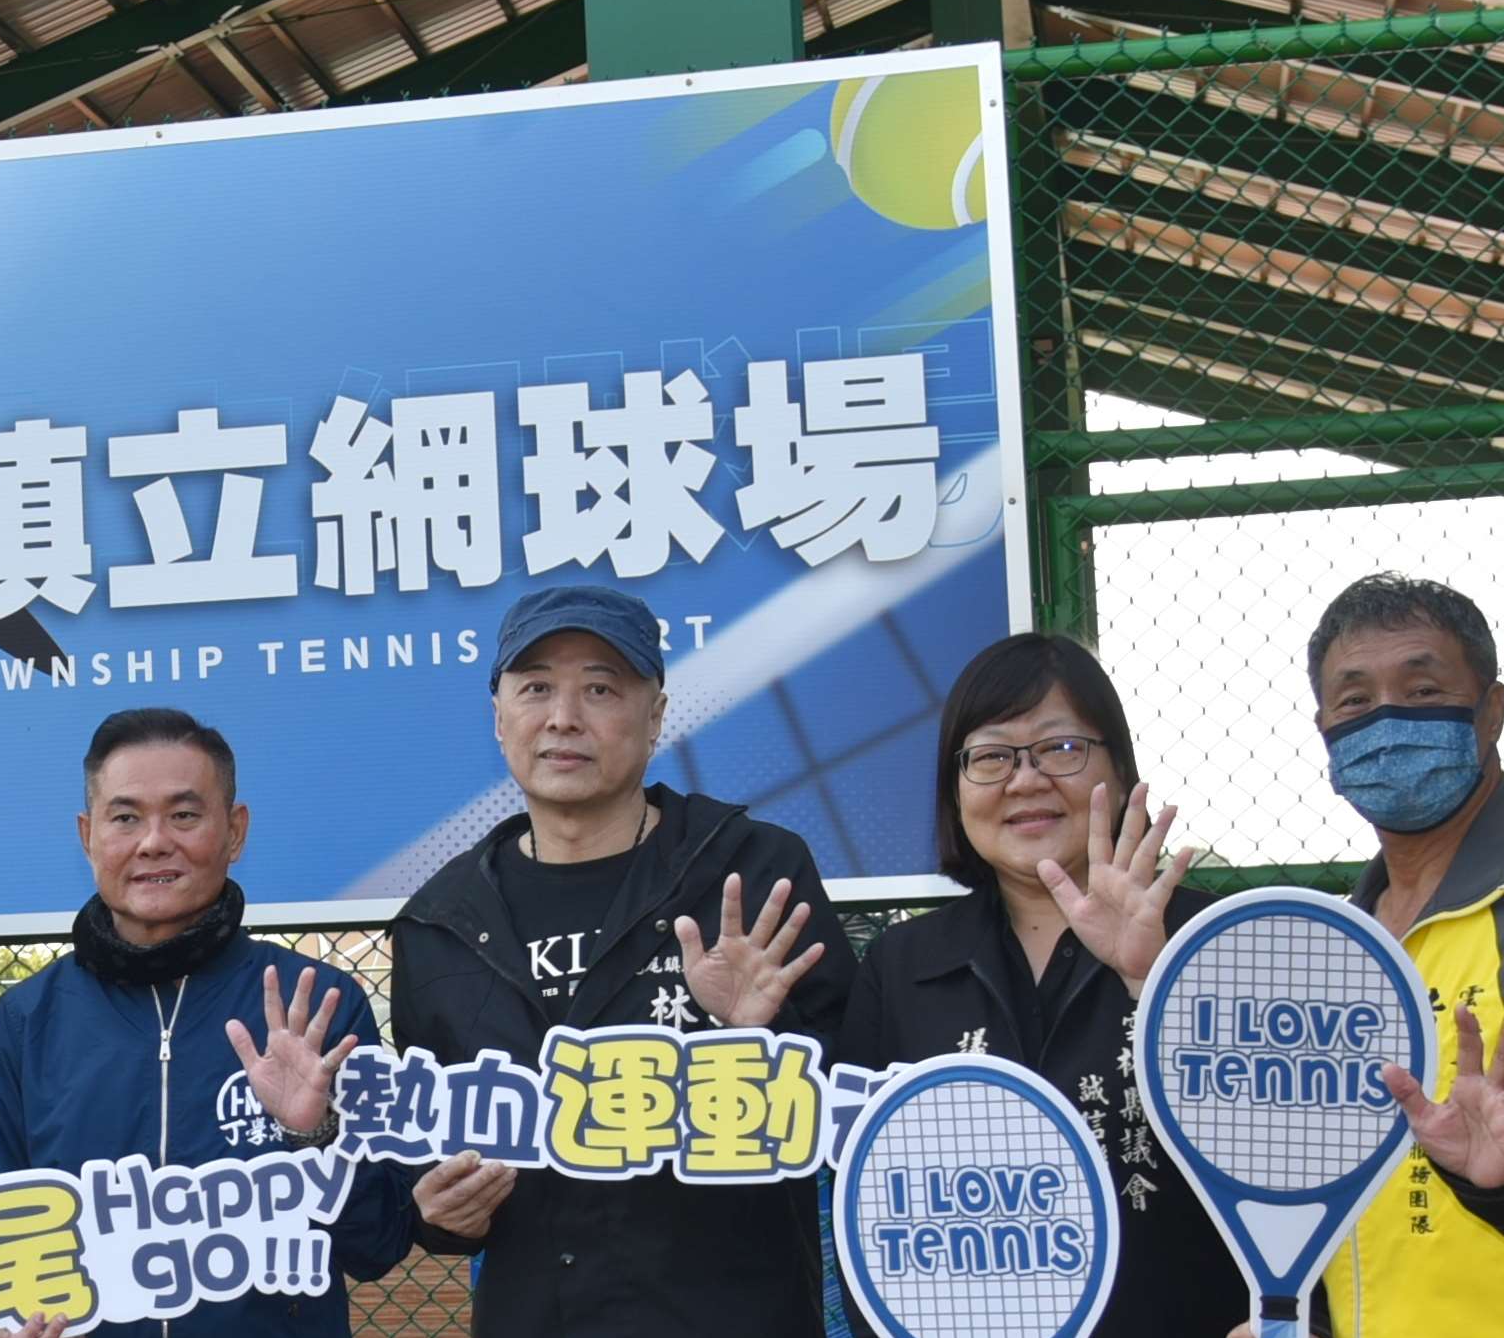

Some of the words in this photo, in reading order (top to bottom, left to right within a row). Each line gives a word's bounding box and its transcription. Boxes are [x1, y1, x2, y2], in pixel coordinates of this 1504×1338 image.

[258, 629, 480, 675] TENNIS
[1194, 996, 1215, 1045] I
[339, 1034, 890, 1174] 熱血運動
[93, 1156, 349, 1234] Happy
[887, 1168, 910, 1218] I
